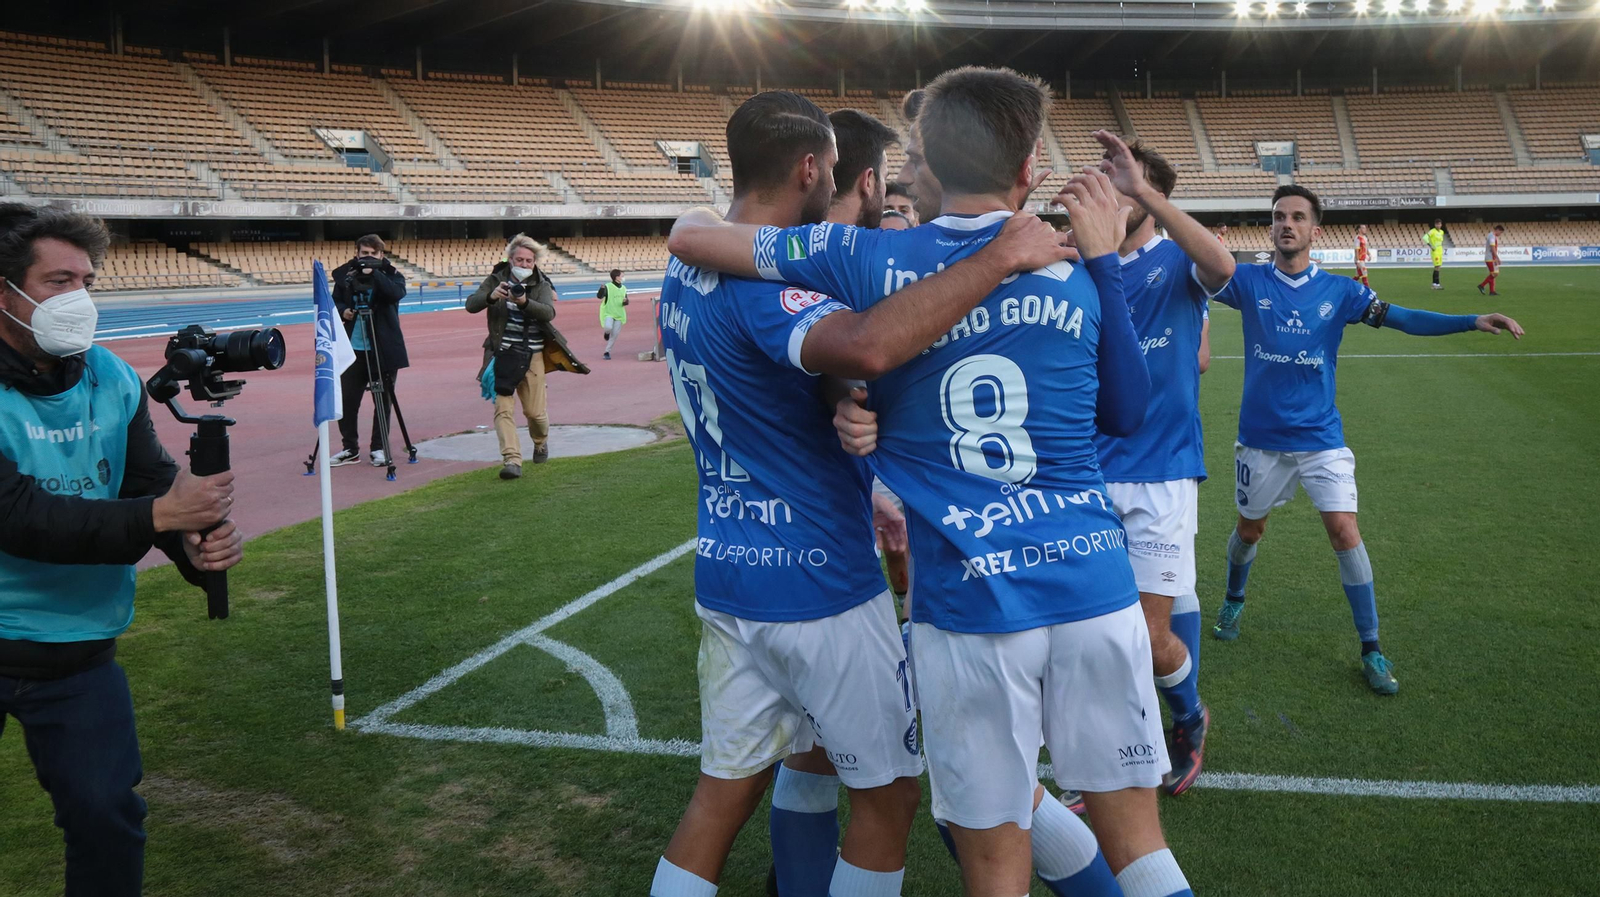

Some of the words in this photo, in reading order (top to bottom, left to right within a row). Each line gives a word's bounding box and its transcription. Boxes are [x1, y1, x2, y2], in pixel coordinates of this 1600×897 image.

[86, 201, 140, 214] Cruzcampo
[212, 203, 260, 215] Cruzcampo
[1001, 294, 1084, 340] GOMA
[1292, 328, 1311, 336] PEPE
[1254, 344, 1292, 363] Promo
[939, 354, 1038, 485] 8
[1236, 459, 1250, 487] 10
